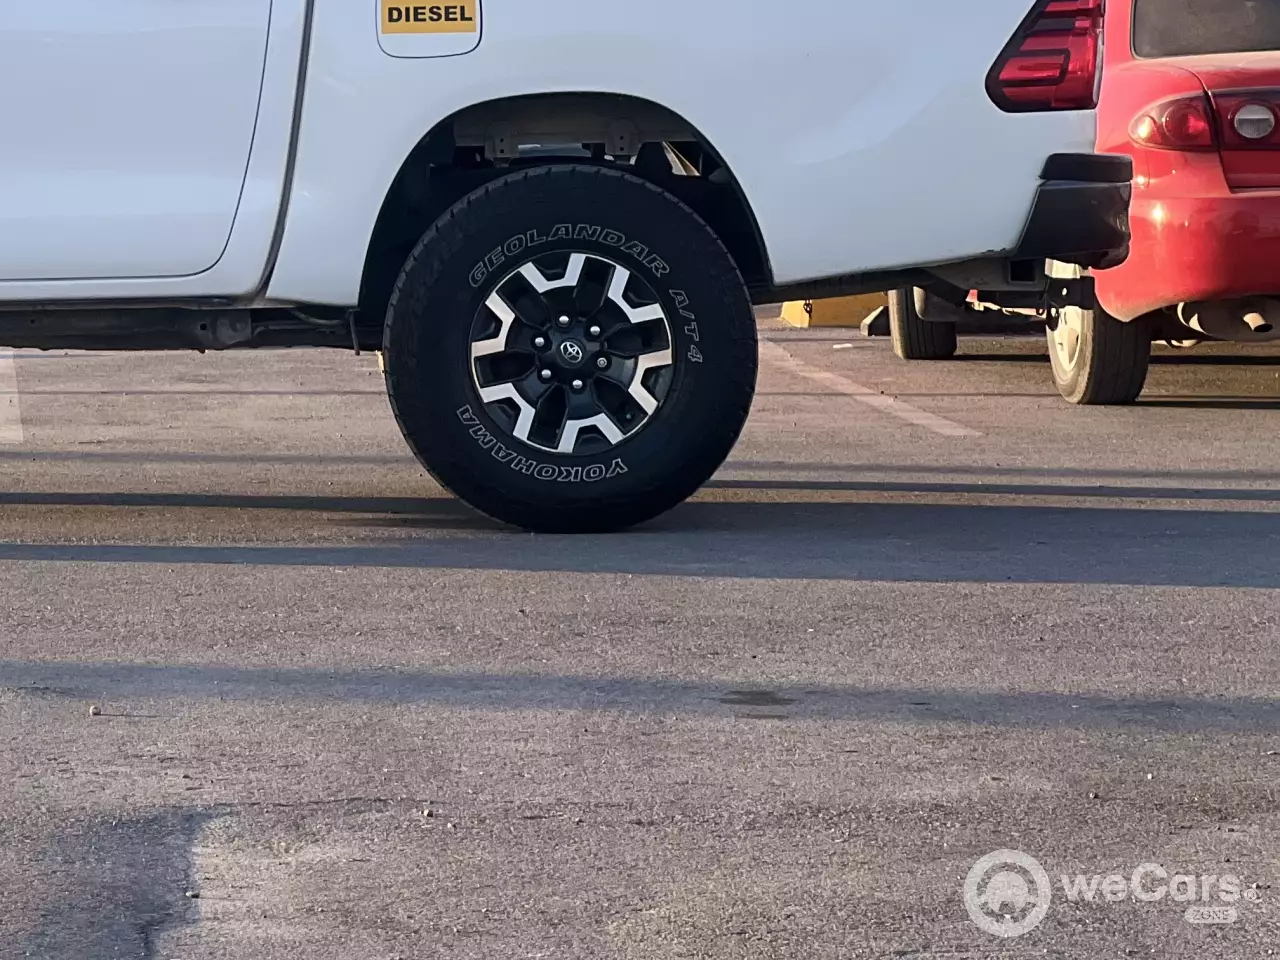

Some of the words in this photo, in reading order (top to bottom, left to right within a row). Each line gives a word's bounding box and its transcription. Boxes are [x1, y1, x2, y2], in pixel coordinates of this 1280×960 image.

[387, 5, 473, 23] DIESEL
[468, 224, 671, 288] GEOLANDAR
[455, 404, 629, 483] YOKOHAMA
